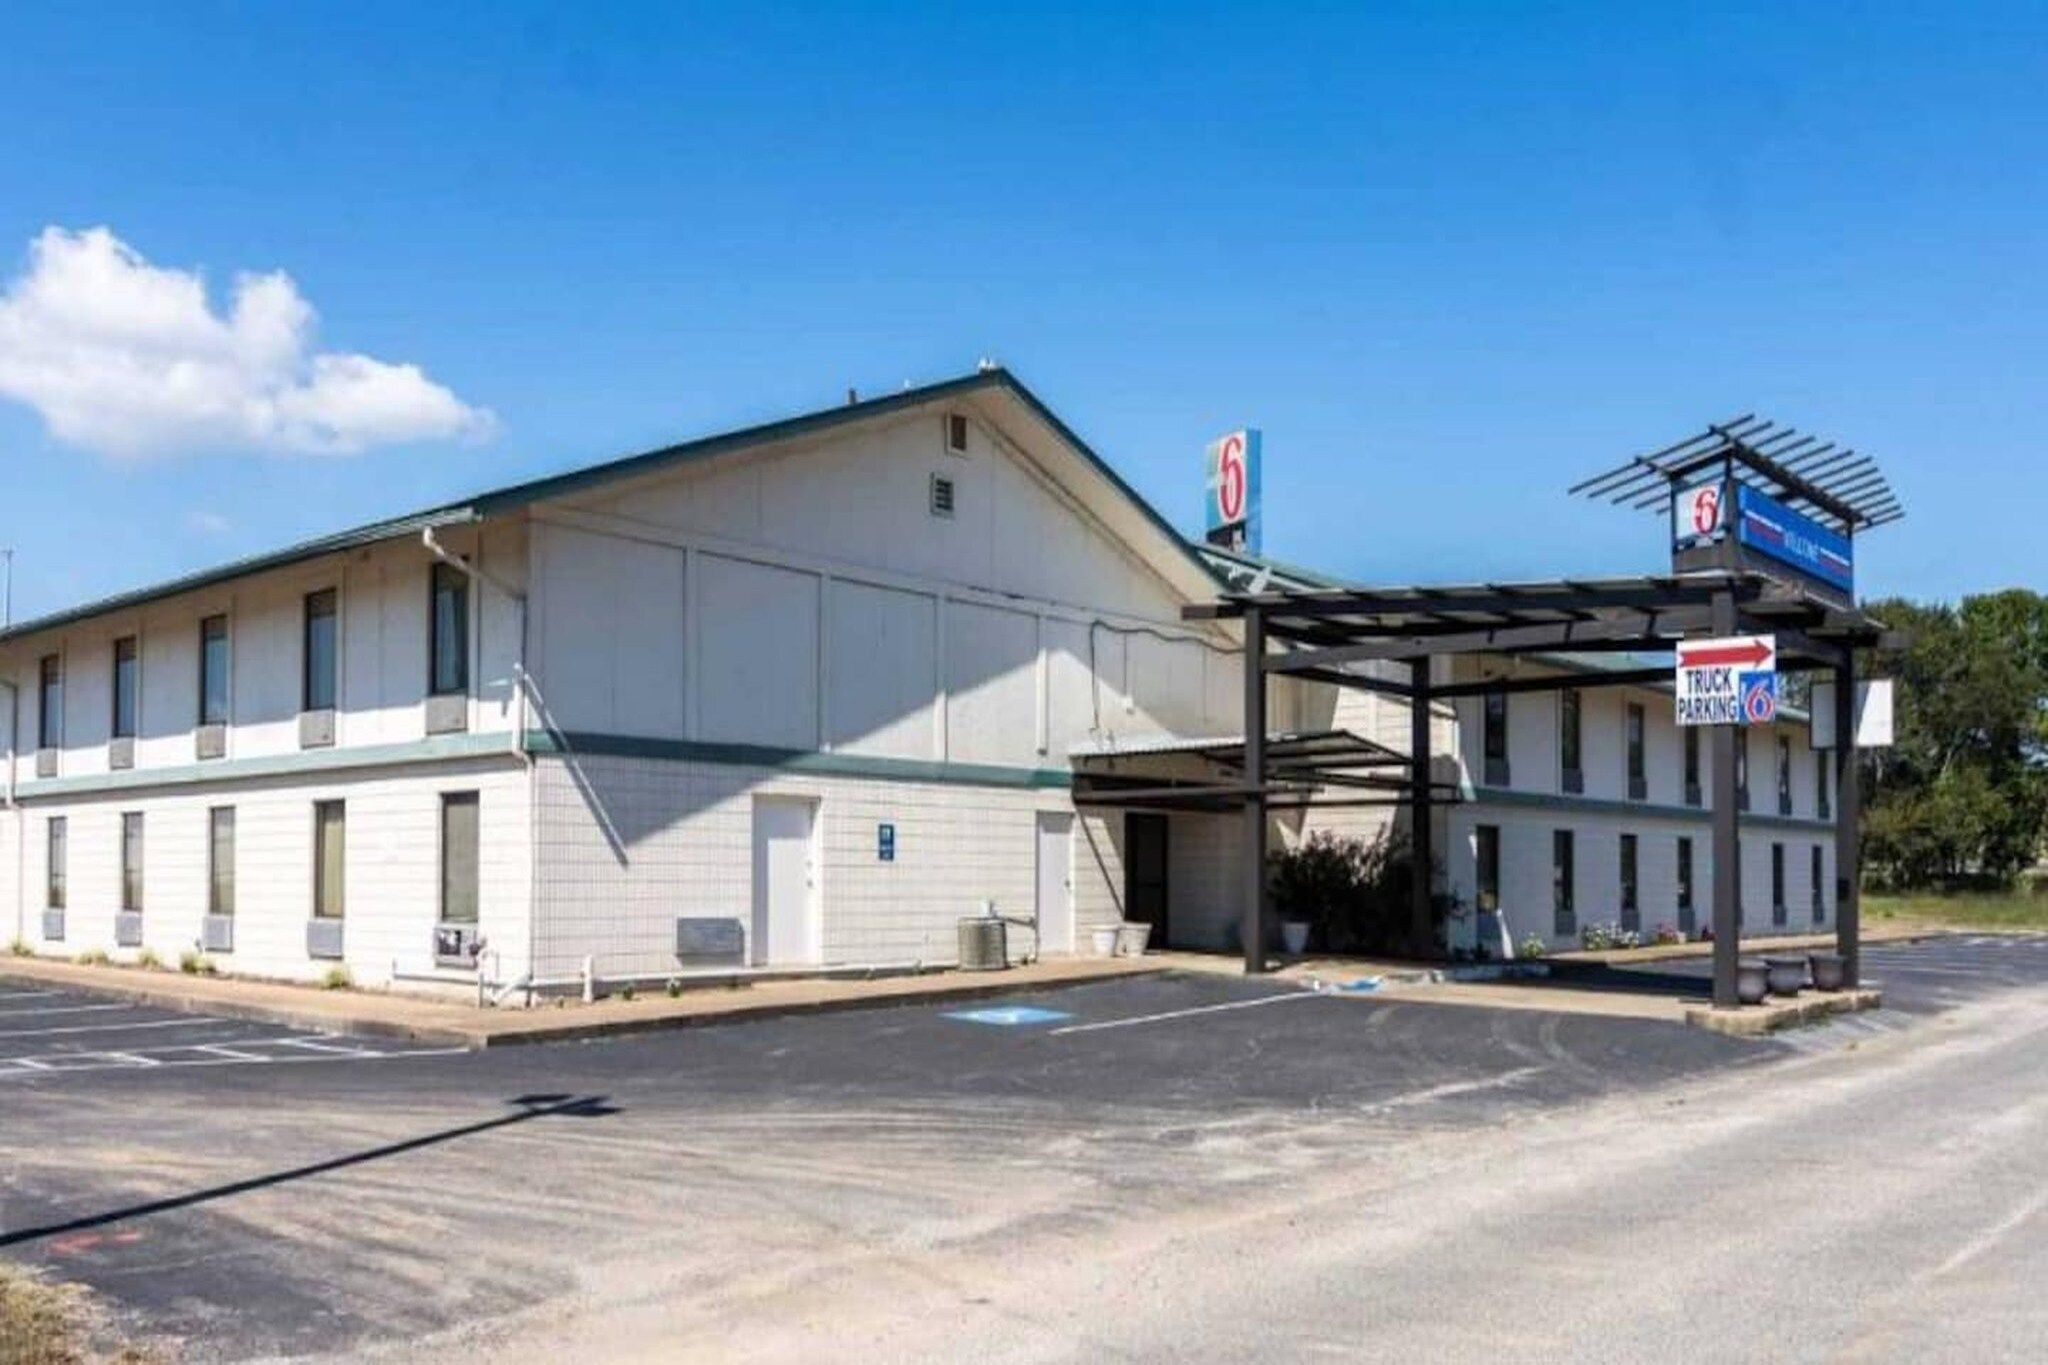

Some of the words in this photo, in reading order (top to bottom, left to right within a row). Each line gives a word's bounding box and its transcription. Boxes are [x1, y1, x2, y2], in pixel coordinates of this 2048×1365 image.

[1219, 436, 1243, 520] 6
[1695, 489, 1718, 535] 6
[1686, 667, 1733, 694] TRUCK
[1745, 680, 1774, 724] 6
[1679, 695, 1738, 721] PARKING
